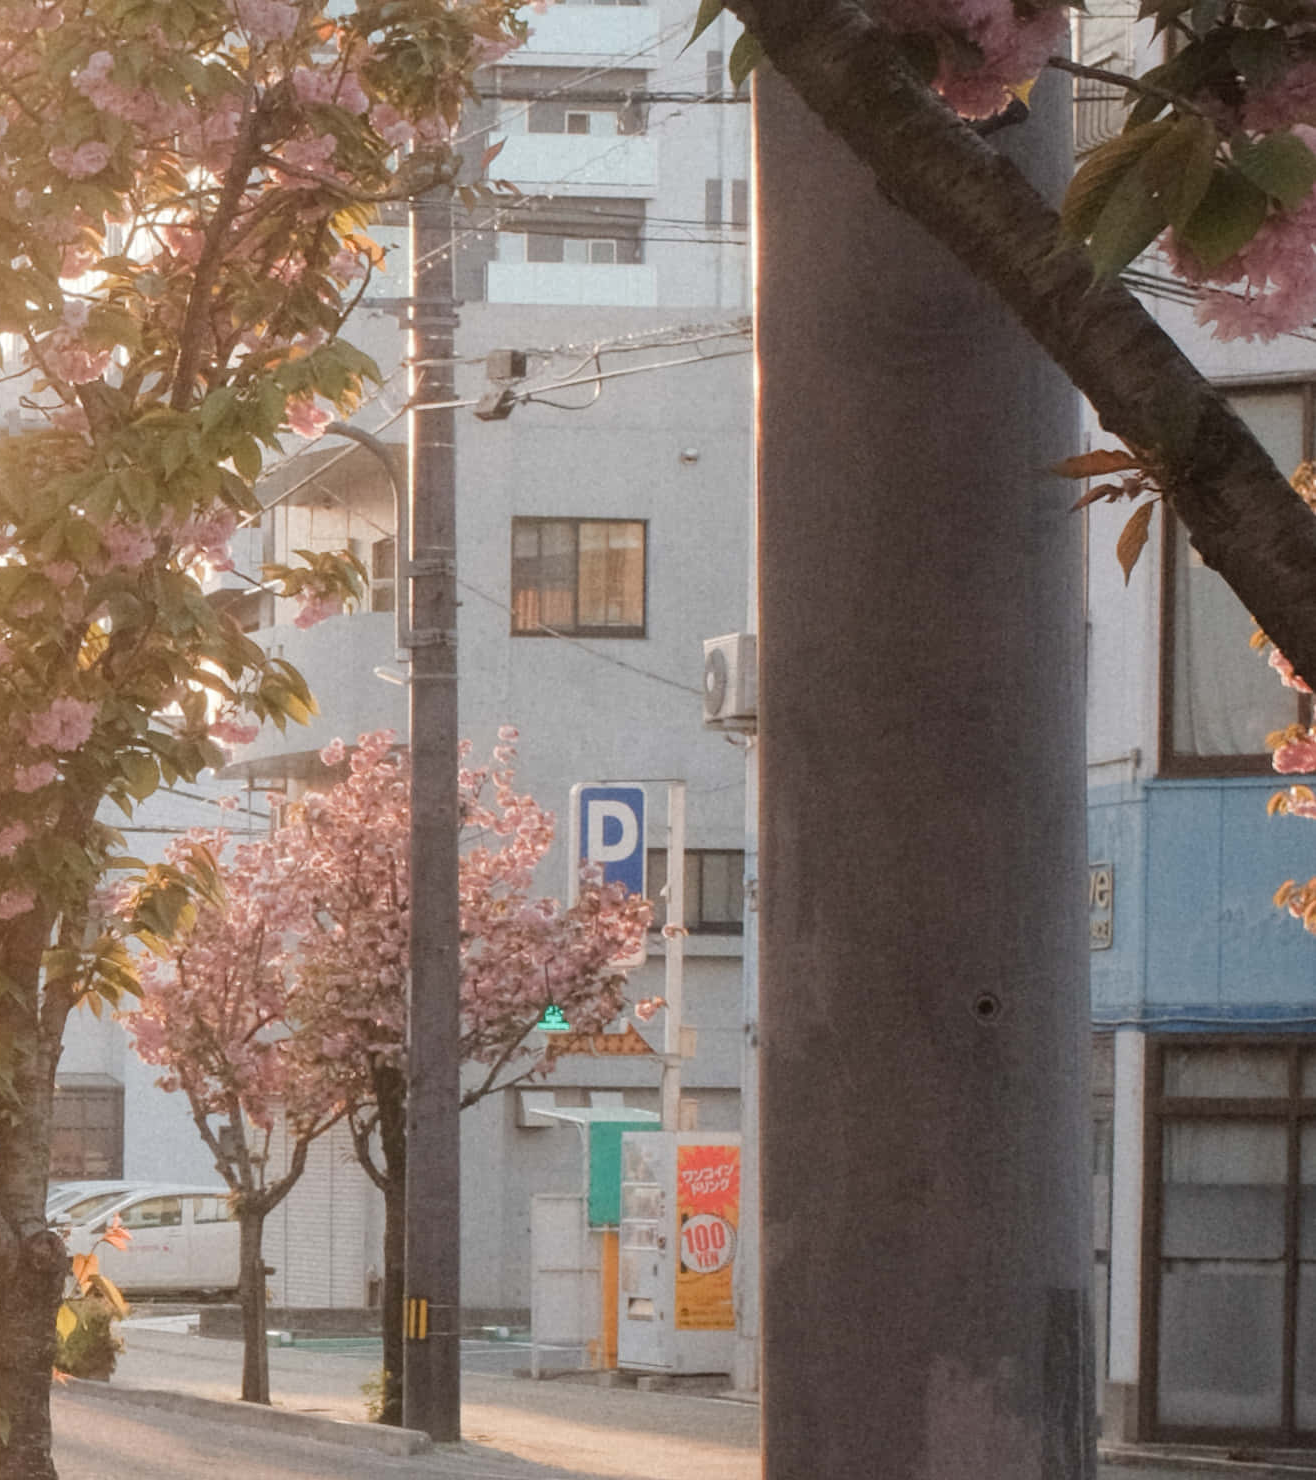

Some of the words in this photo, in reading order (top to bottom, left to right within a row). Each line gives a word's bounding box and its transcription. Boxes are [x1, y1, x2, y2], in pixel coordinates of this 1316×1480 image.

[682, 1163, 734, 1184] ワンコイン
[682, 1222, 725, 1254] 100
[697, 1251, 719, 1267] YEN
